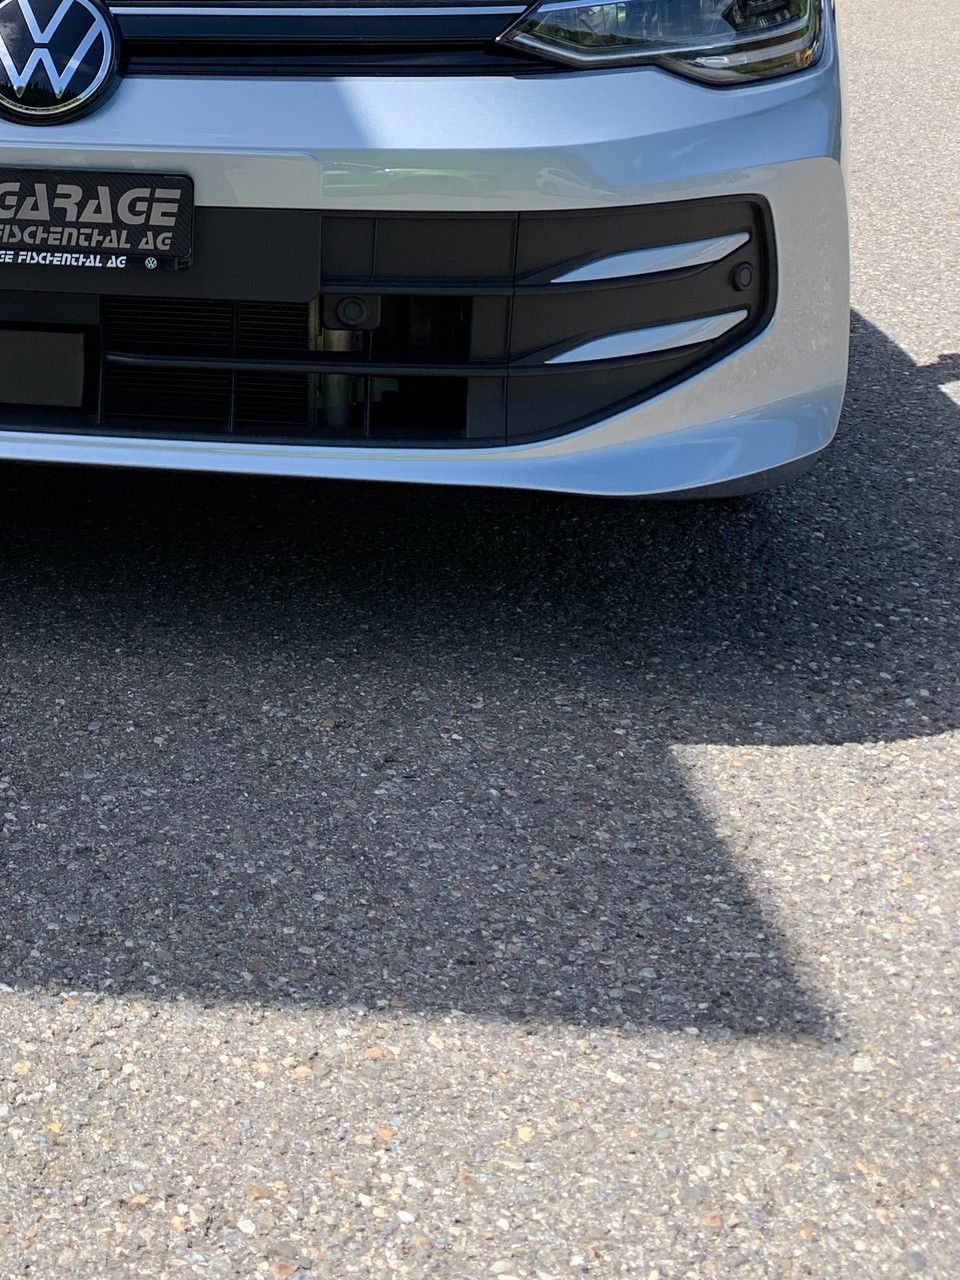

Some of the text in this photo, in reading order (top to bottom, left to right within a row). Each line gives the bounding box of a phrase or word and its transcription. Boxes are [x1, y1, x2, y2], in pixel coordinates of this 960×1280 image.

[137, 230, 173, 251] AG
[17, 250, 103, 267] FISCHENTHAL
[106, 255, 127, 268] AG
